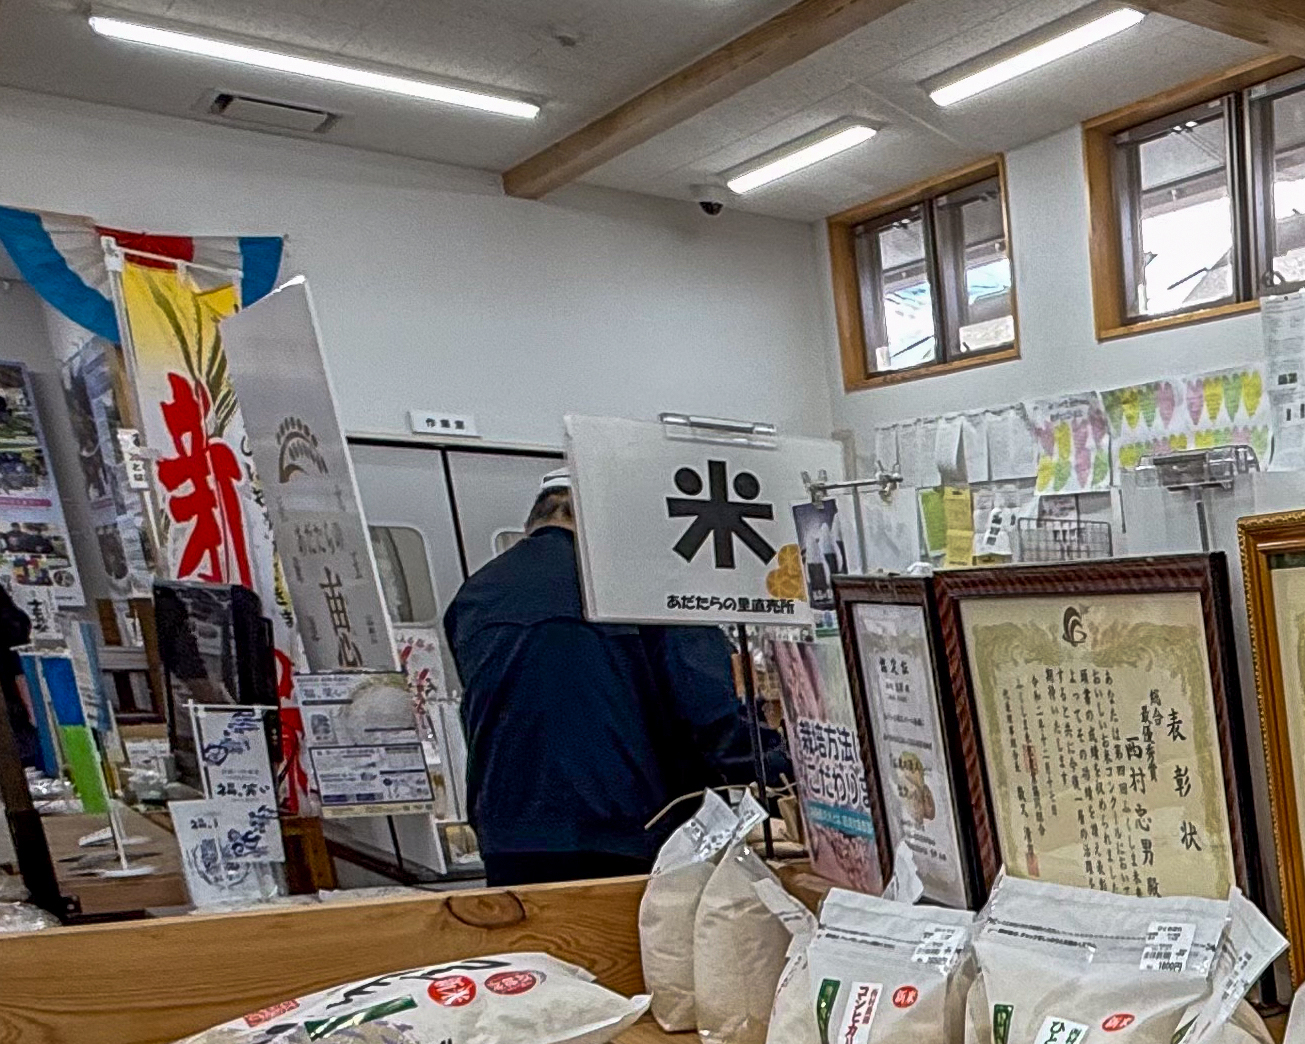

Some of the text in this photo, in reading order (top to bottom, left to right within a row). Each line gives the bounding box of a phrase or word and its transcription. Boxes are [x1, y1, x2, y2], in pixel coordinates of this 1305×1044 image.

[665, 459, 777, 570] 米
[666, 594, 796, 615] あだたらの里直売所
[1166, 708, 1203, 852] 表彰状
